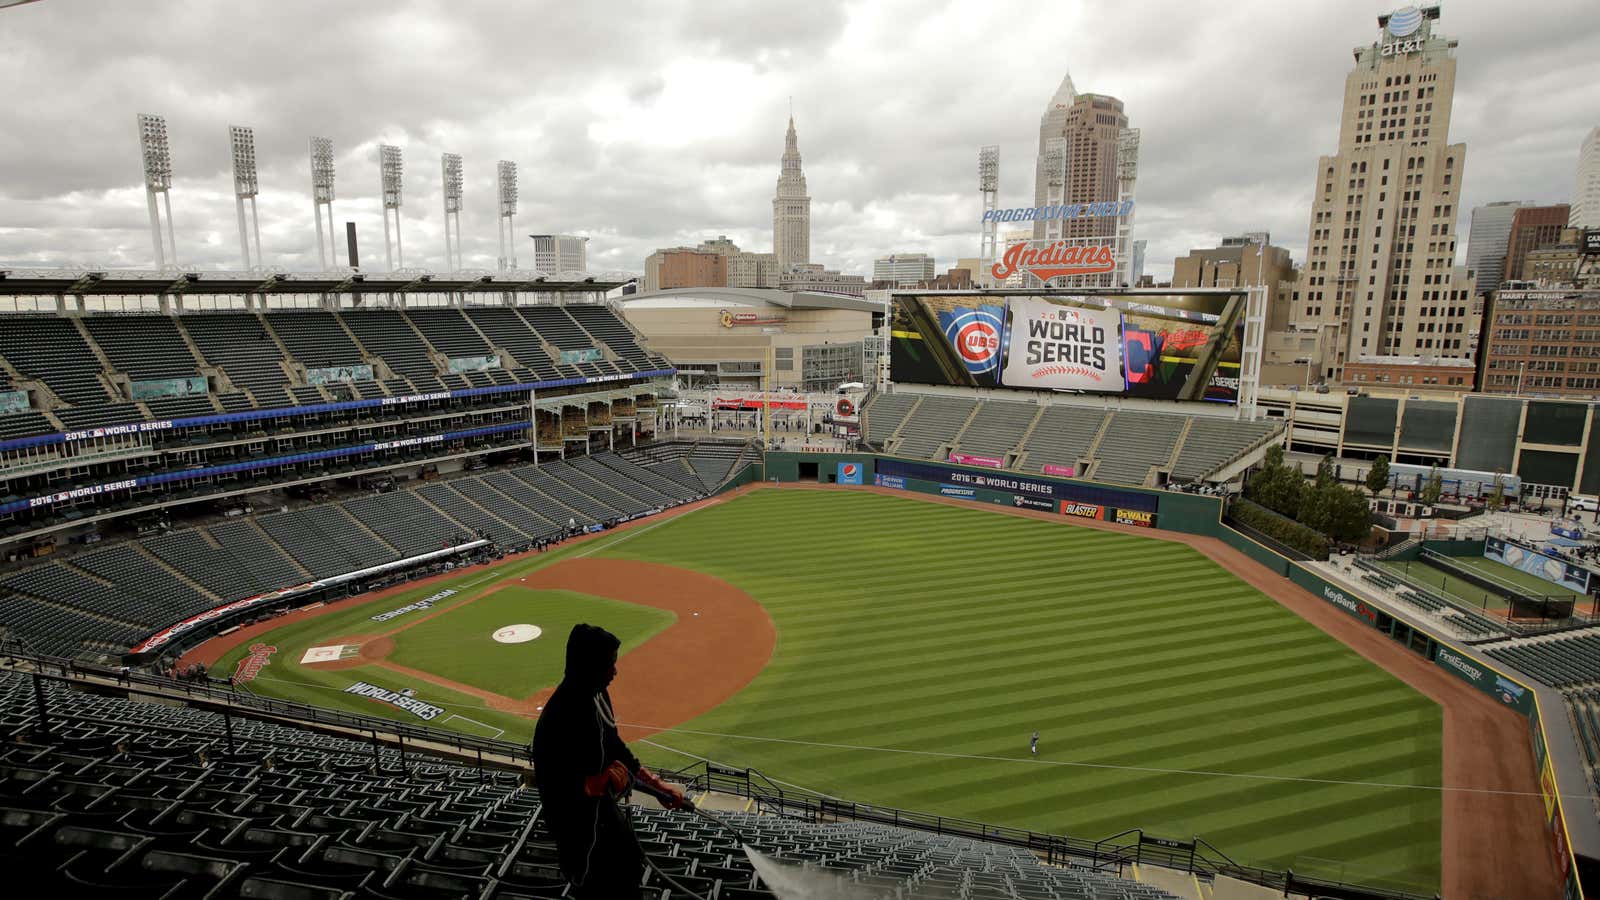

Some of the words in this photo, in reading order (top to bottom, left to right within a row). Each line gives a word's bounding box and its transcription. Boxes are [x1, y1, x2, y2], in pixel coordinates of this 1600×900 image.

[981, 203, 1081, 224] PROGRESSIVE
[1085, 200, 1134, 217] FIELD
[992, 240, 1116, 282] Indians
[1029, 319, 1105, 344] WORLD
[1026, 340, 1106, 370] SERIES
[382, 397, 396, 405] 2016
[430, 391, 451, 399] SERIES
[65, 432, 87, 440] 2016
[104, 425, 138, 436] WORLD
[140, 421, 173, 431] SERIES
[400, 437, 422, 446] WORLD
[422, 434, 444, 443] SERIES
[30, 496, 52, 506] 2016
[69, 486, 102, 498] WORLD
[104, 479, 136, 492] SERIES
[951, 473, 970, 482] 2016
[986, 478, 1017, 489] WORLD
[1020, 482, 1053, 494] SERIES
[1066, 503, 1097, 518] BLASTER
[1324, 585, 1357, 612] KeyBank
[344, 681, 397, 702] WORLD
[393, 696, 446, 720] SERIES
